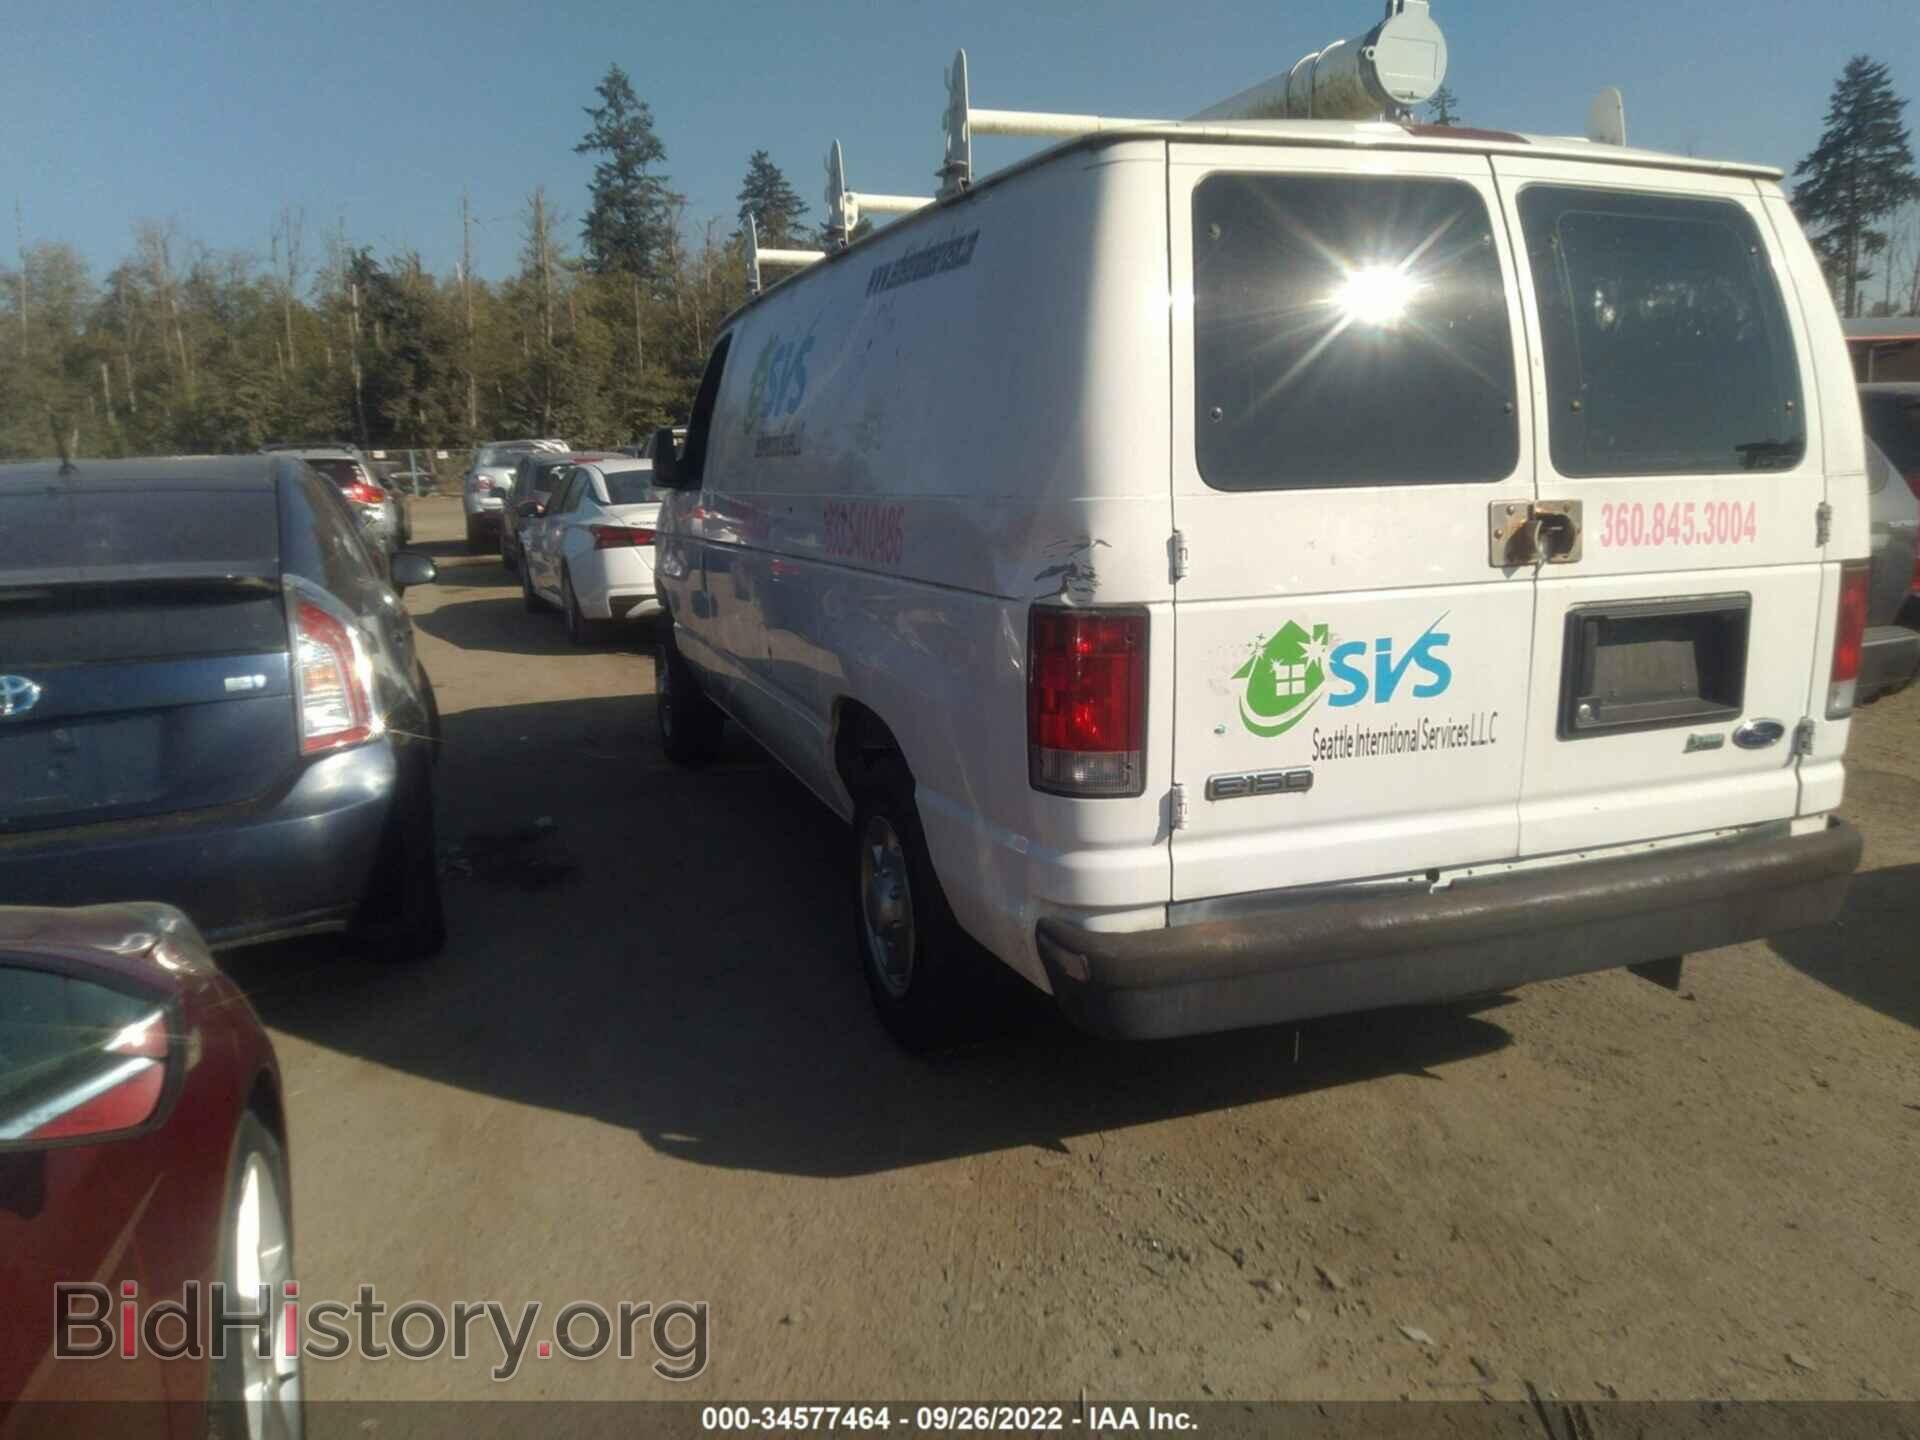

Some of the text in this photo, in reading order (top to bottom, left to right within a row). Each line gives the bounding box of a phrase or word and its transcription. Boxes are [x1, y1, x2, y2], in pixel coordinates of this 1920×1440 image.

[1600, 501, 1757, 547] 360.845.3004
[1312, 723, 1354, 761] Seattle
[1354, 717, 1420, 757] Interntional
[1421, 716, 1469, 750] Services
